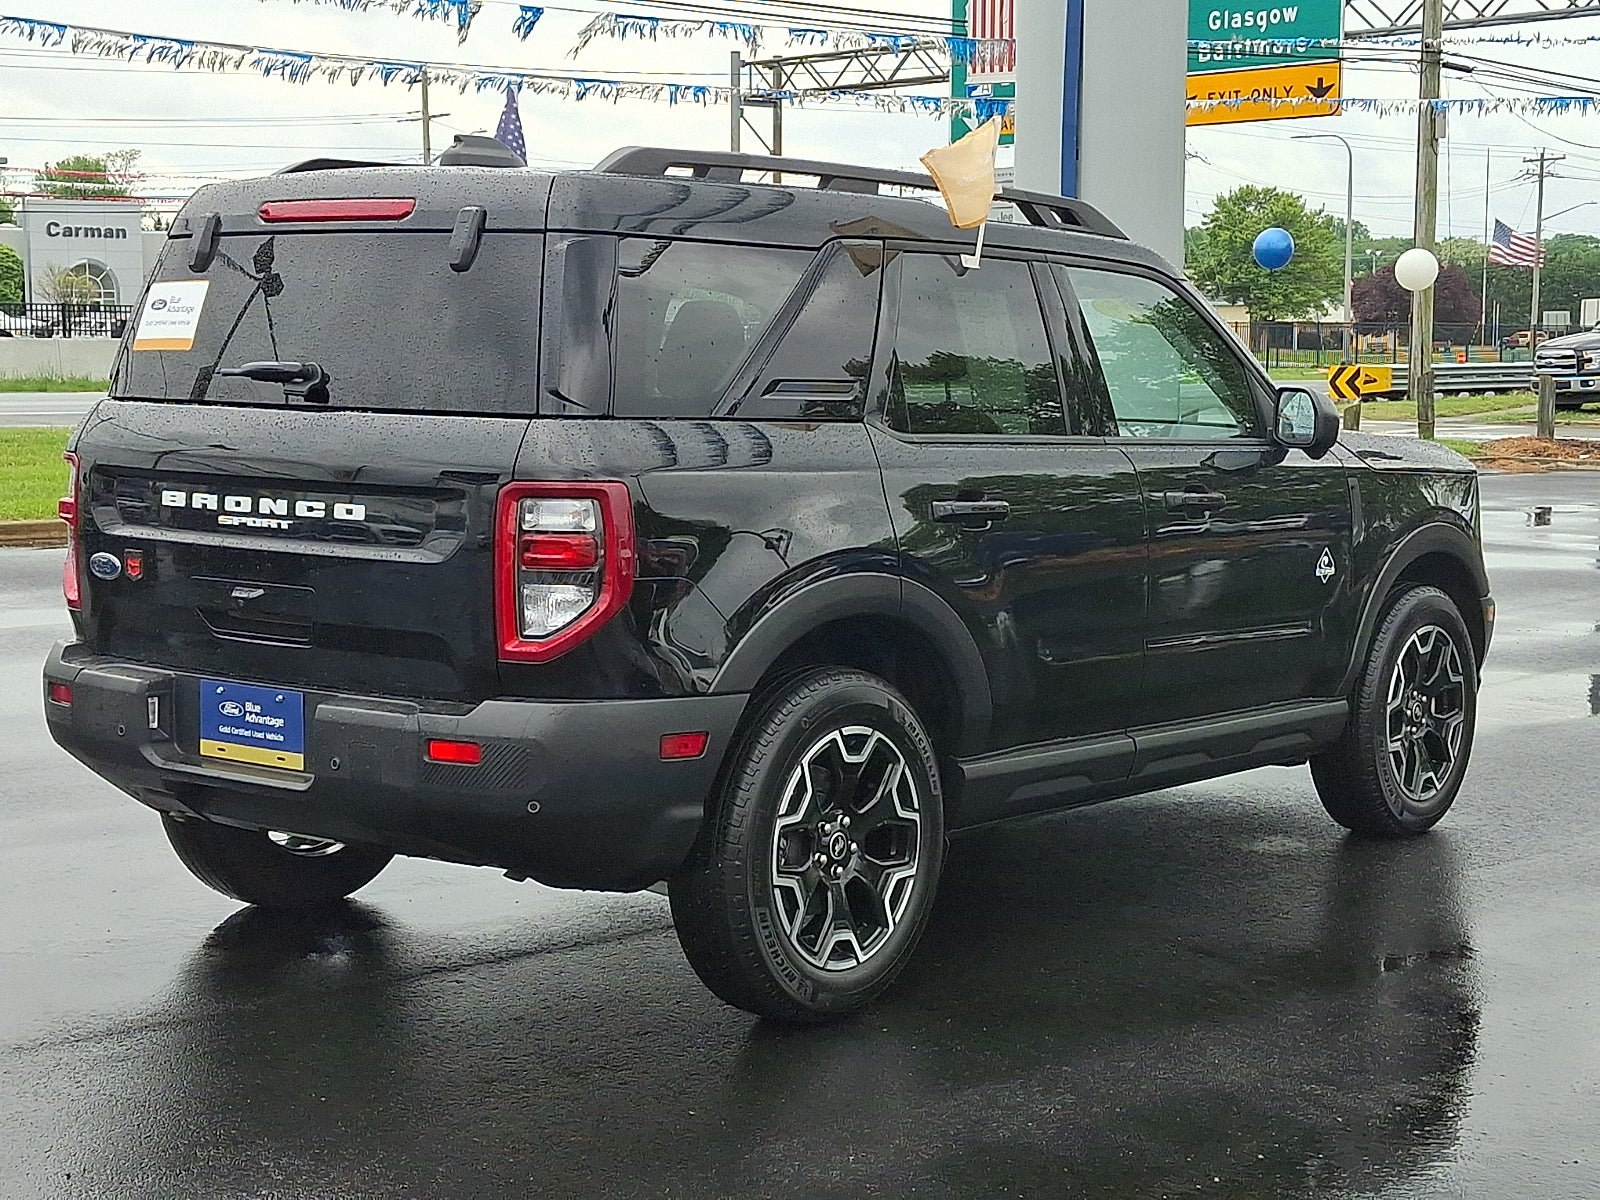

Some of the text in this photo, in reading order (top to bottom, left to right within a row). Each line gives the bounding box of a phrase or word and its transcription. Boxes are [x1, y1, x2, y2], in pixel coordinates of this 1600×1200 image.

[1208, 6, 1299, 32] Glasgow
[46, 221, 128, 239] Carman
[161, 490, 367, 521] BRONCO
[217, 515, 294, 530] SPORT
[245, 702, 261, 713] Blue
[245, 713, 285, 728] Advantage
[218, 725, 231, 734] Gold
[758, 911, 798, 985] MICHELIN
